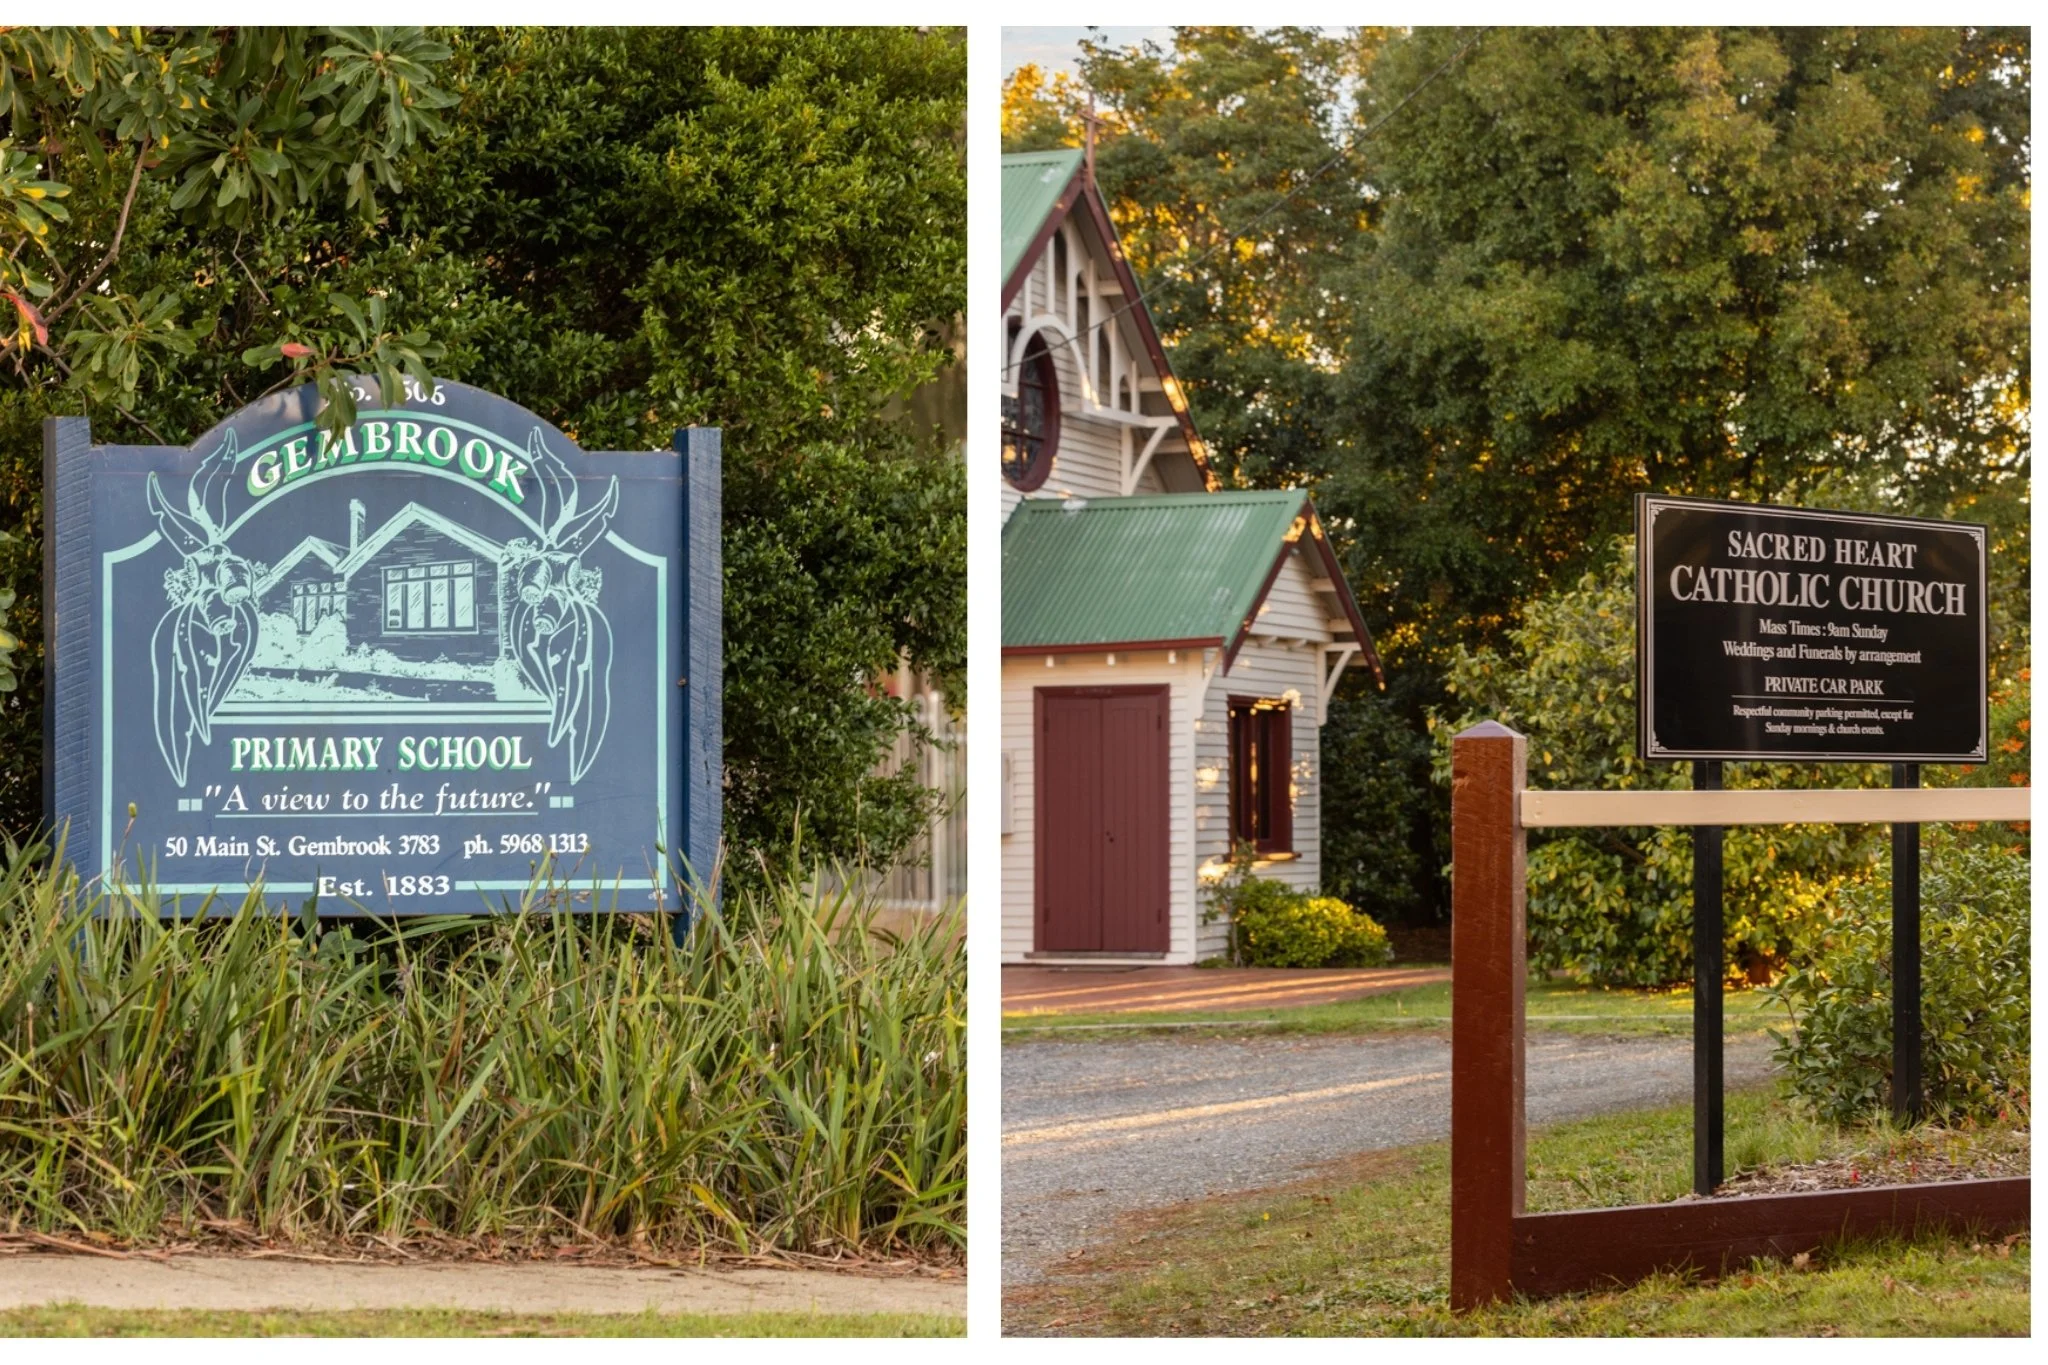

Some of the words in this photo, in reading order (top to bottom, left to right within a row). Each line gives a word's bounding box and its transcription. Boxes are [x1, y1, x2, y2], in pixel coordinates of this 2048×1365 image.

[388, 379, 446, 406] 506
[247, 421, 528, 504] GEMBROOK
[1728, 530, 1826, 563] SACRED
[1834, 538, 1917, 570] HEART
[1670, 565, 1830, 609] CATHOLIC
[1839, 576, 1967, 616] CHURCH
[1759, 618, 1787, 635] Mass
[1827, 622, 1850, 638] 9am
[1852, 623, 1888, 643] Sunday
[1723, 640, 1774, 660] Weddings
[1776, 644, 1796, 659] and
[1799, 643, 1843, 661] Funerals
[1845, 648, 1857, 664] by
[1859, 650, 1921, 665] arrangement
[1764, 676, 1818, 693] PRIVATE
[1820, 677, 1847, 694] CAR
[1850, 679, 1884, 695] PARK
[1733, 704, 1772, 718] Respectful
[1773, 706, 1814, 720] community
[1815, 707, 1843, 720] parking
[1844, 708, 1880, 720] permitted,
[1880, 710, 1902, 722] except
[1903, 709, 1914, 720] for
[1765, 722, 1792, 736] Sunday
[1793, 723, 1827, 736] mornings
[1828, 723, 1835, 734] &
[1836, 723, 1860, 735] church
[230, 737, 383, 771] PRIMARY
[398, 736, 532, 771] SCHOOL
[205, 784, 249, 811] "A
[262, 785, 330, 810] view
[342, 789, 369, 810] to
[380, 783, 424, 810] the
[434, 782, 551, 815] future."
[165, 836, 188, 857] 50
[194, 836, 249, 857] Main
[256, 835, 281, 857] St.
[288, 834, 391, 857] Gembrook
[398, 834, 440, 855] 3783
[463, 833, 493, 859] ph.
[499, 833, 542, 854] 5968
[549, 833, 589, 854] 1313
[317, 876, 373, 897] Est.
[387, 875, 450, 896] 1883
